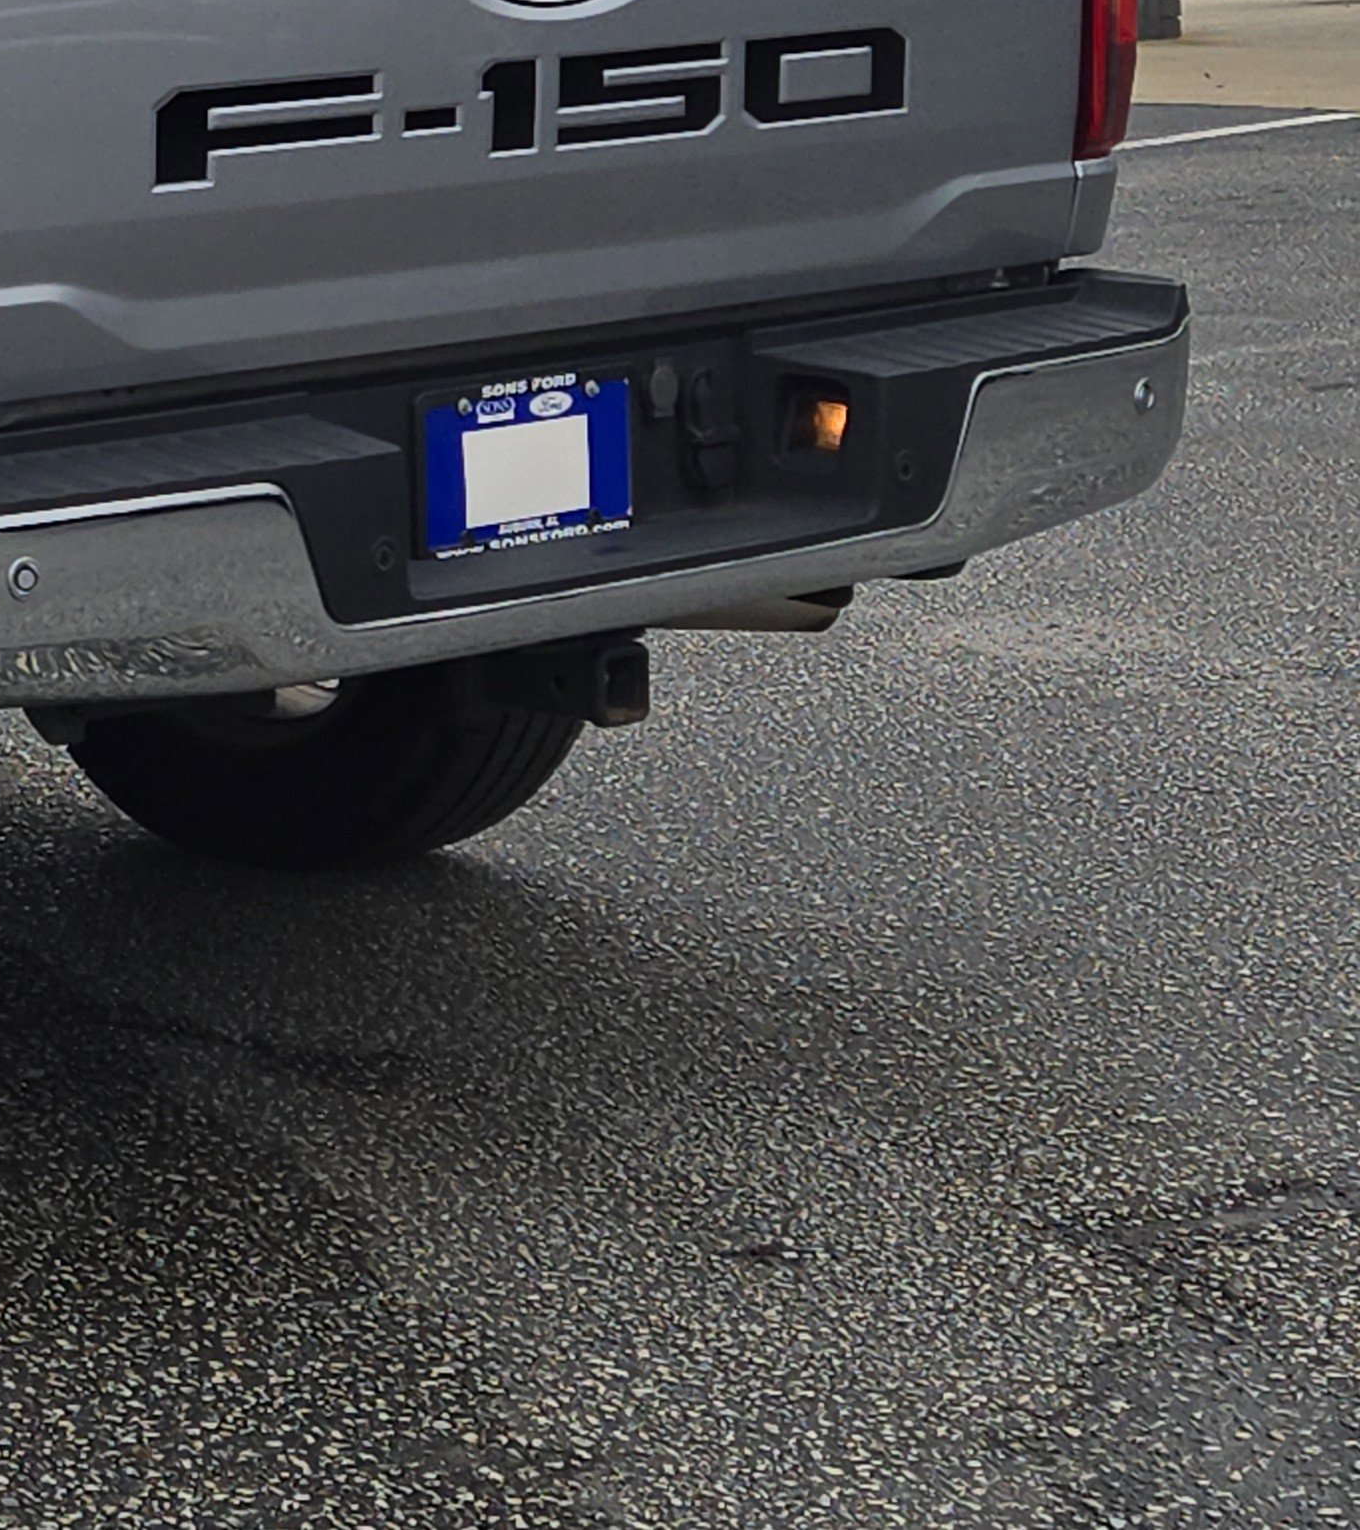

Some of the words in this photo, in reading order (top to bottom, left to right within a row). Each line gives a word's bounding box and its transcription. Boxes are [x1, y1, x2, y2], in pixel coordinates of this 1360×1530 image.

[151, 26, 909, 194] F-150
[481, 378, 528, 399] SONS
[530, 372, 576, 392] FORD
[435, 519, 630, 560] wwwSONSFORD.com
